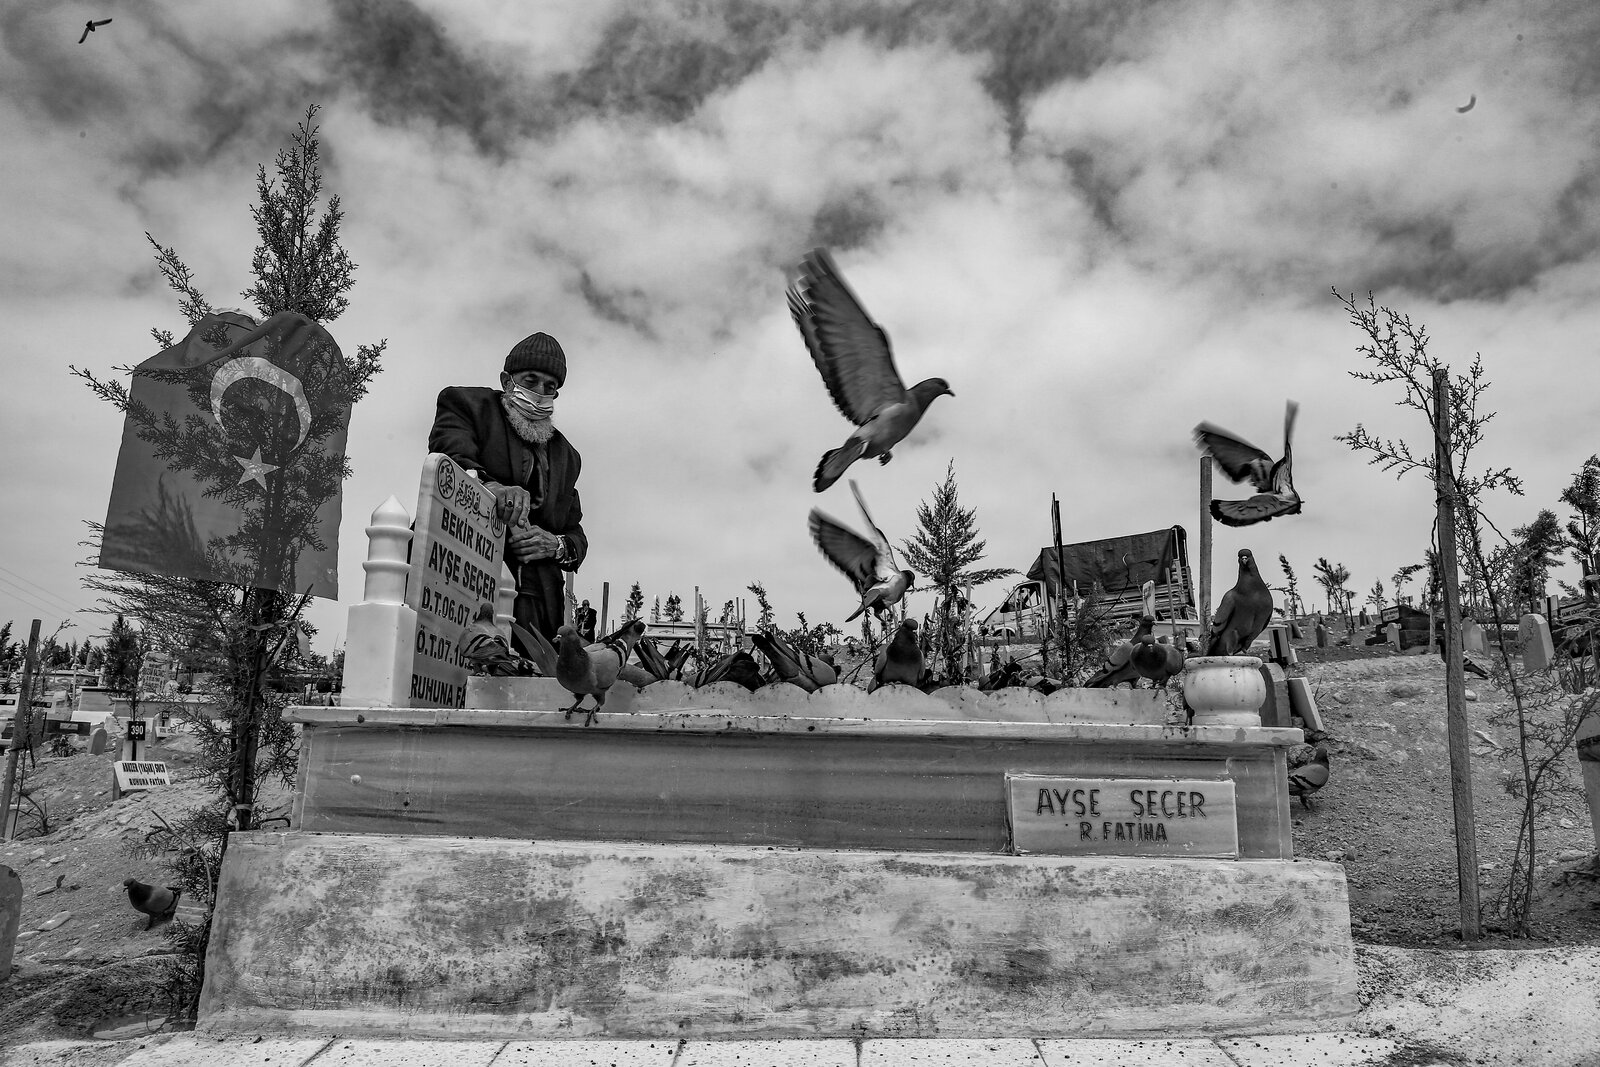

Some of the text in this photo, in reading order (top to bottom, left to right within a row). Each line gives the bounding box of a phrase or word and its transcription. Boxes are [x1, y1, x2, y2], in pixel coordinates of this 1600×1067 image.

[441, 507, 473, 549] BEKİR
[475, 531, 494, 563] KIZI
[428, 541, 496, 603] AYŞE SEÇER
[421, 586, 478, 628] D.T.06.07
[416, 624, 474, 670] Ö.T.07.10.
[411, 673, 453, 707] RUHUNA
[130, 725, 144, 735] 390
[1037, 788, 1207, 819] AYSE SECER
